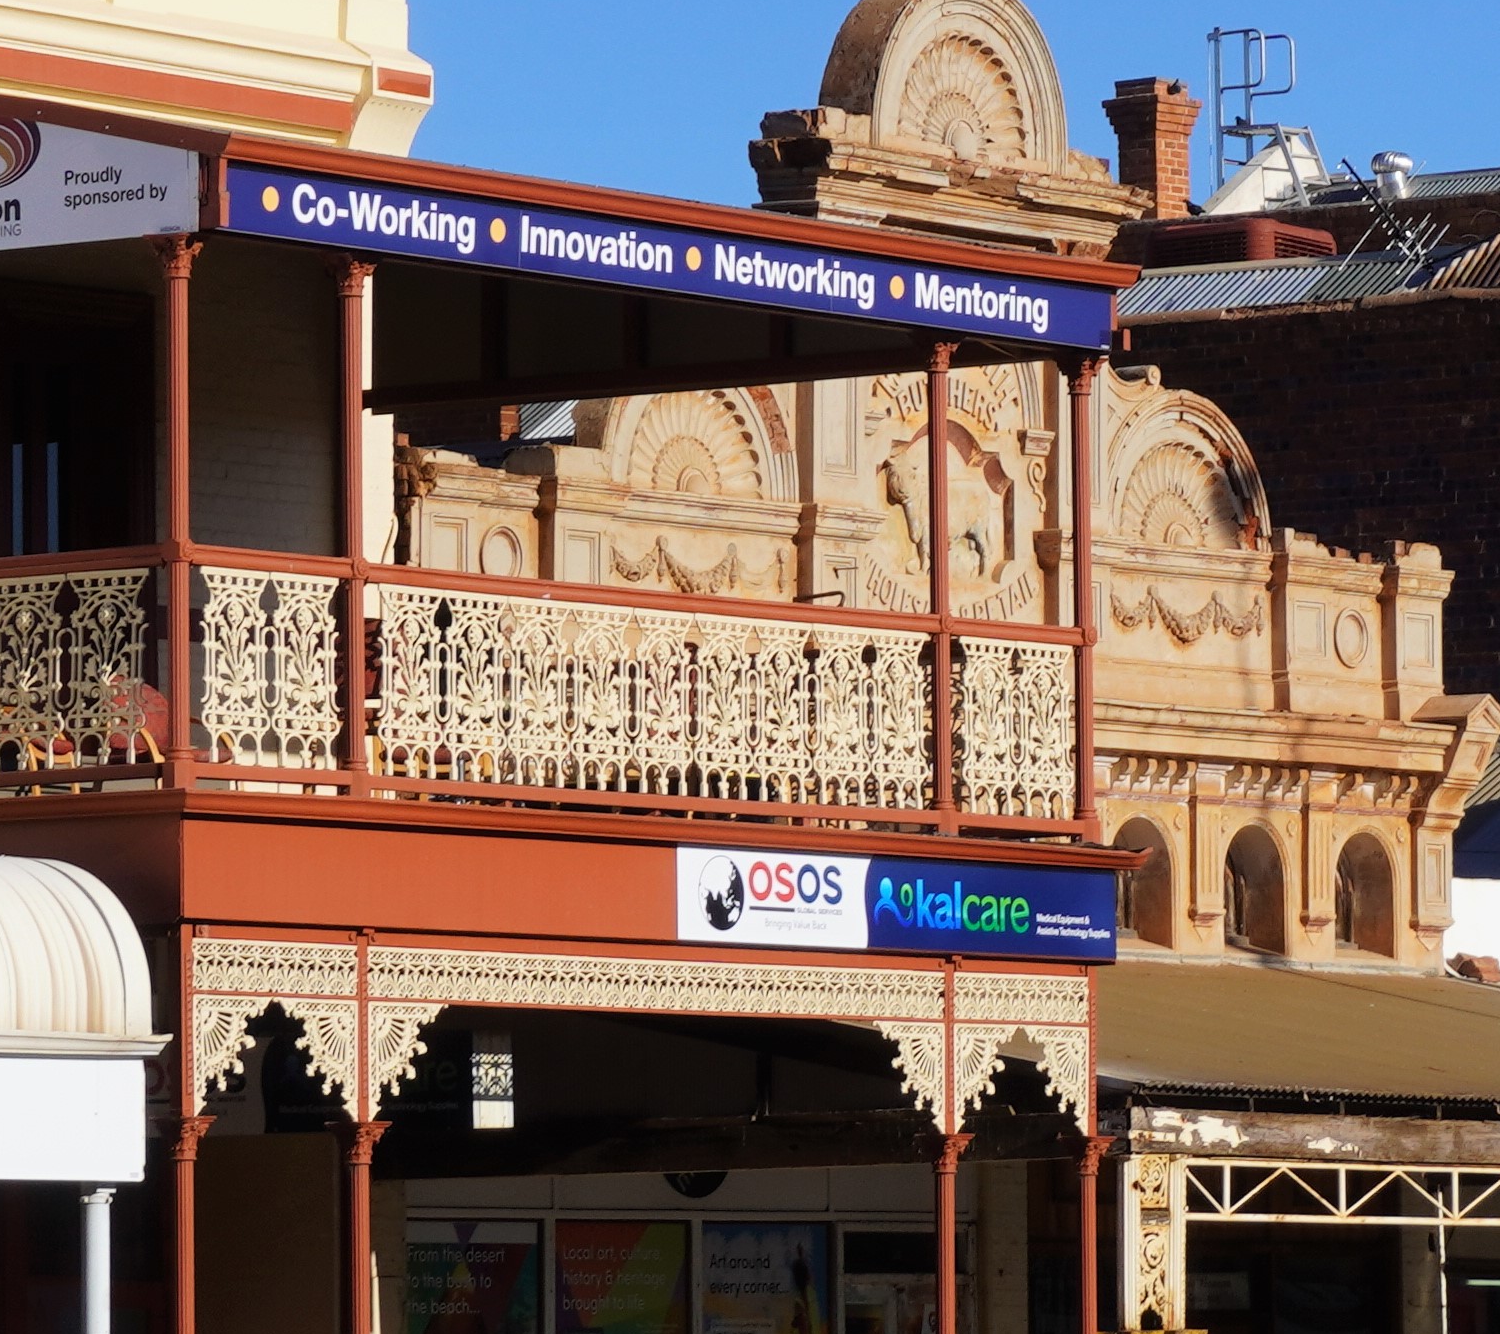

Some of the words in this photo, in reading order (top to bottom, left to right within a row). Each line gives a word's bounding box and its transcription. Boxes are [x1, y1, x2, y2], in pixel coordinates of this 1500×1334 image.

[64, 166, 122, 186] Proudly
[64, 185, 145, 209] sponsored
[150, 184, 168, 201] by
[292, 182, 475, 255] Co-Working
[520, 216, 673, 274] Innovation
[714, 242, 875, 311] Networking
[914, 272, 1049, 335] Mentoring
[749, 860, 843, 905] OSOS
[442, 1245, 462, 1262] the
[466, 1246, 506, 1263] desert
[562, 1245, 594, 1261] Local
[709, 1252, 728, 1269] Art
[729, 1253, 770, 1269] around
[422, 1273, 443, 1288] the
[479, 1273, 492, 1288] to
[562, 1270, 601, 1288] history
[709, 1281, 740, 1298] every
[562, 1295, 611, 1315] brought
